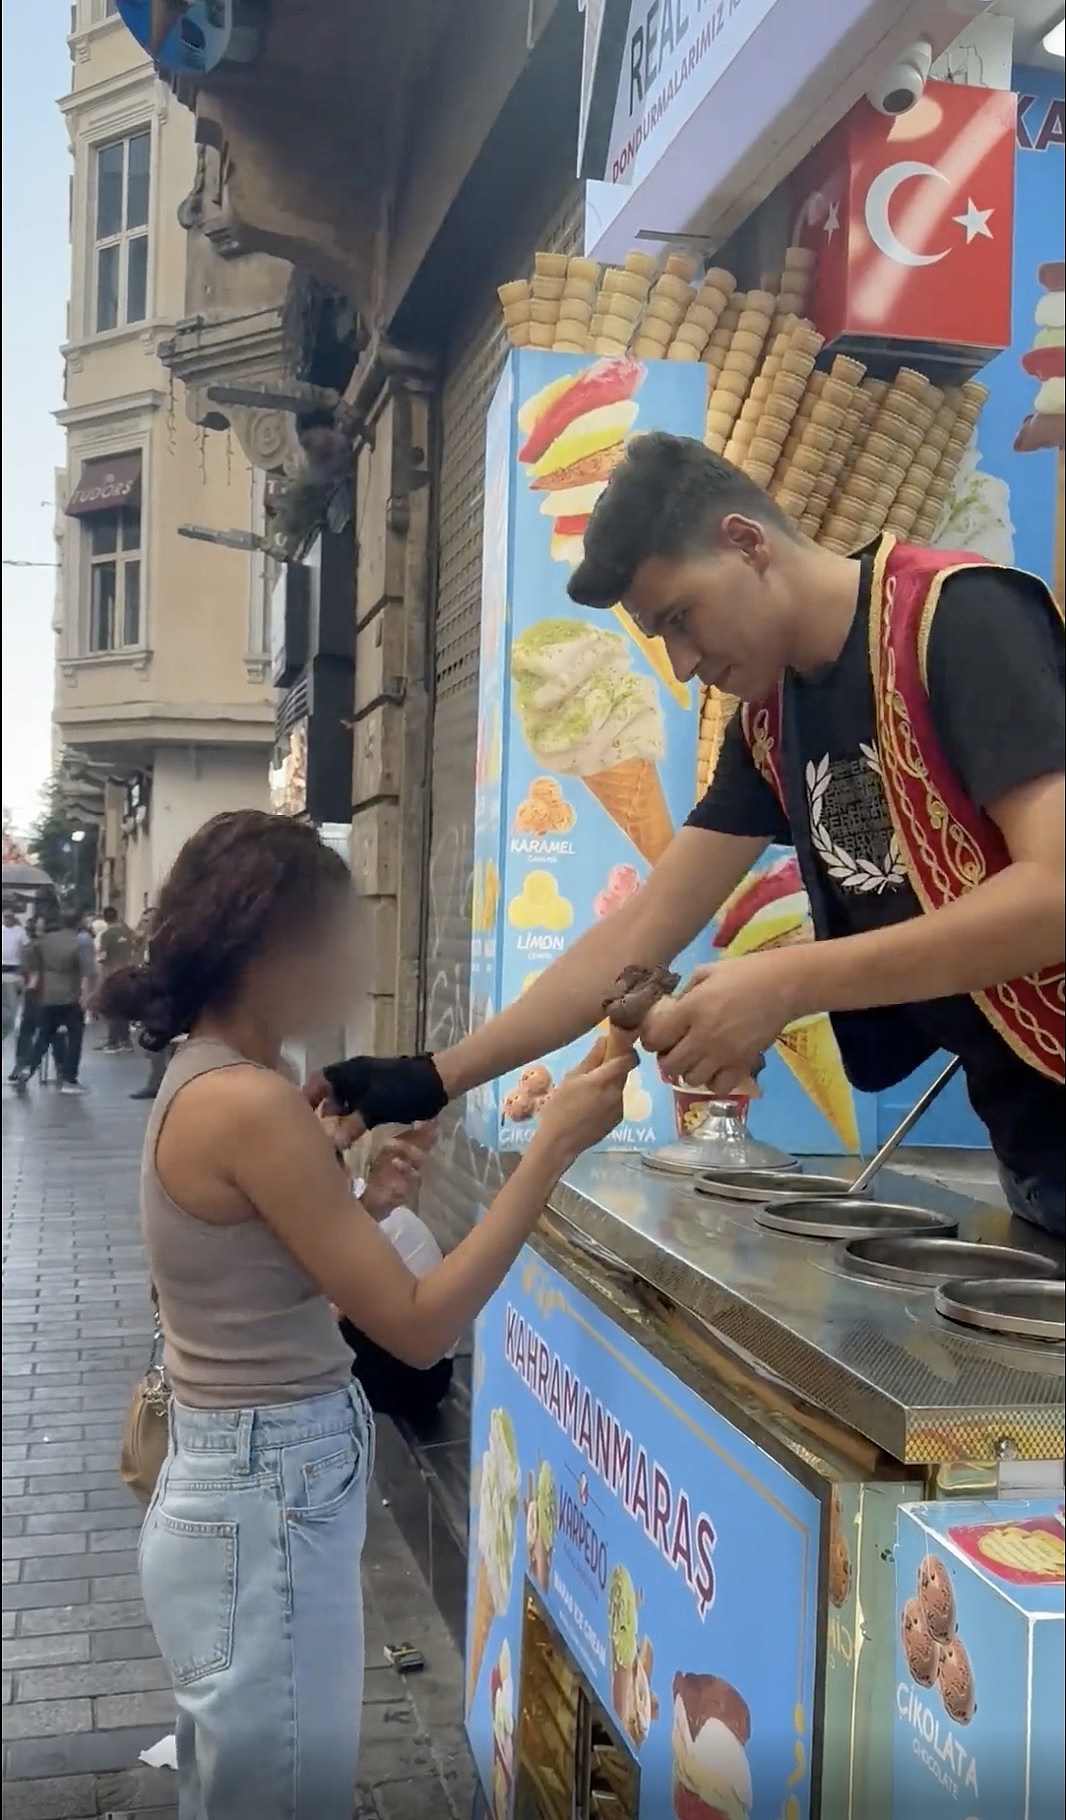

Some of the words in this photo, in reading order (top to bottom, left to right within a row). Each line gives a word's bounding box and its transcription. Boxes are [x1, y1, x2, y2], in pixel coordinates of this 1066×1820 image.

[629, 0, 689, 118] REAL
[71, 480, 134, 504] TUDORS
[510, 838, 576, 855] KARAMEL
[505, 1301, 718, 1622] KAHRAMANMARAŞ
[558, 1485, 608, 1590] KARPEDO
